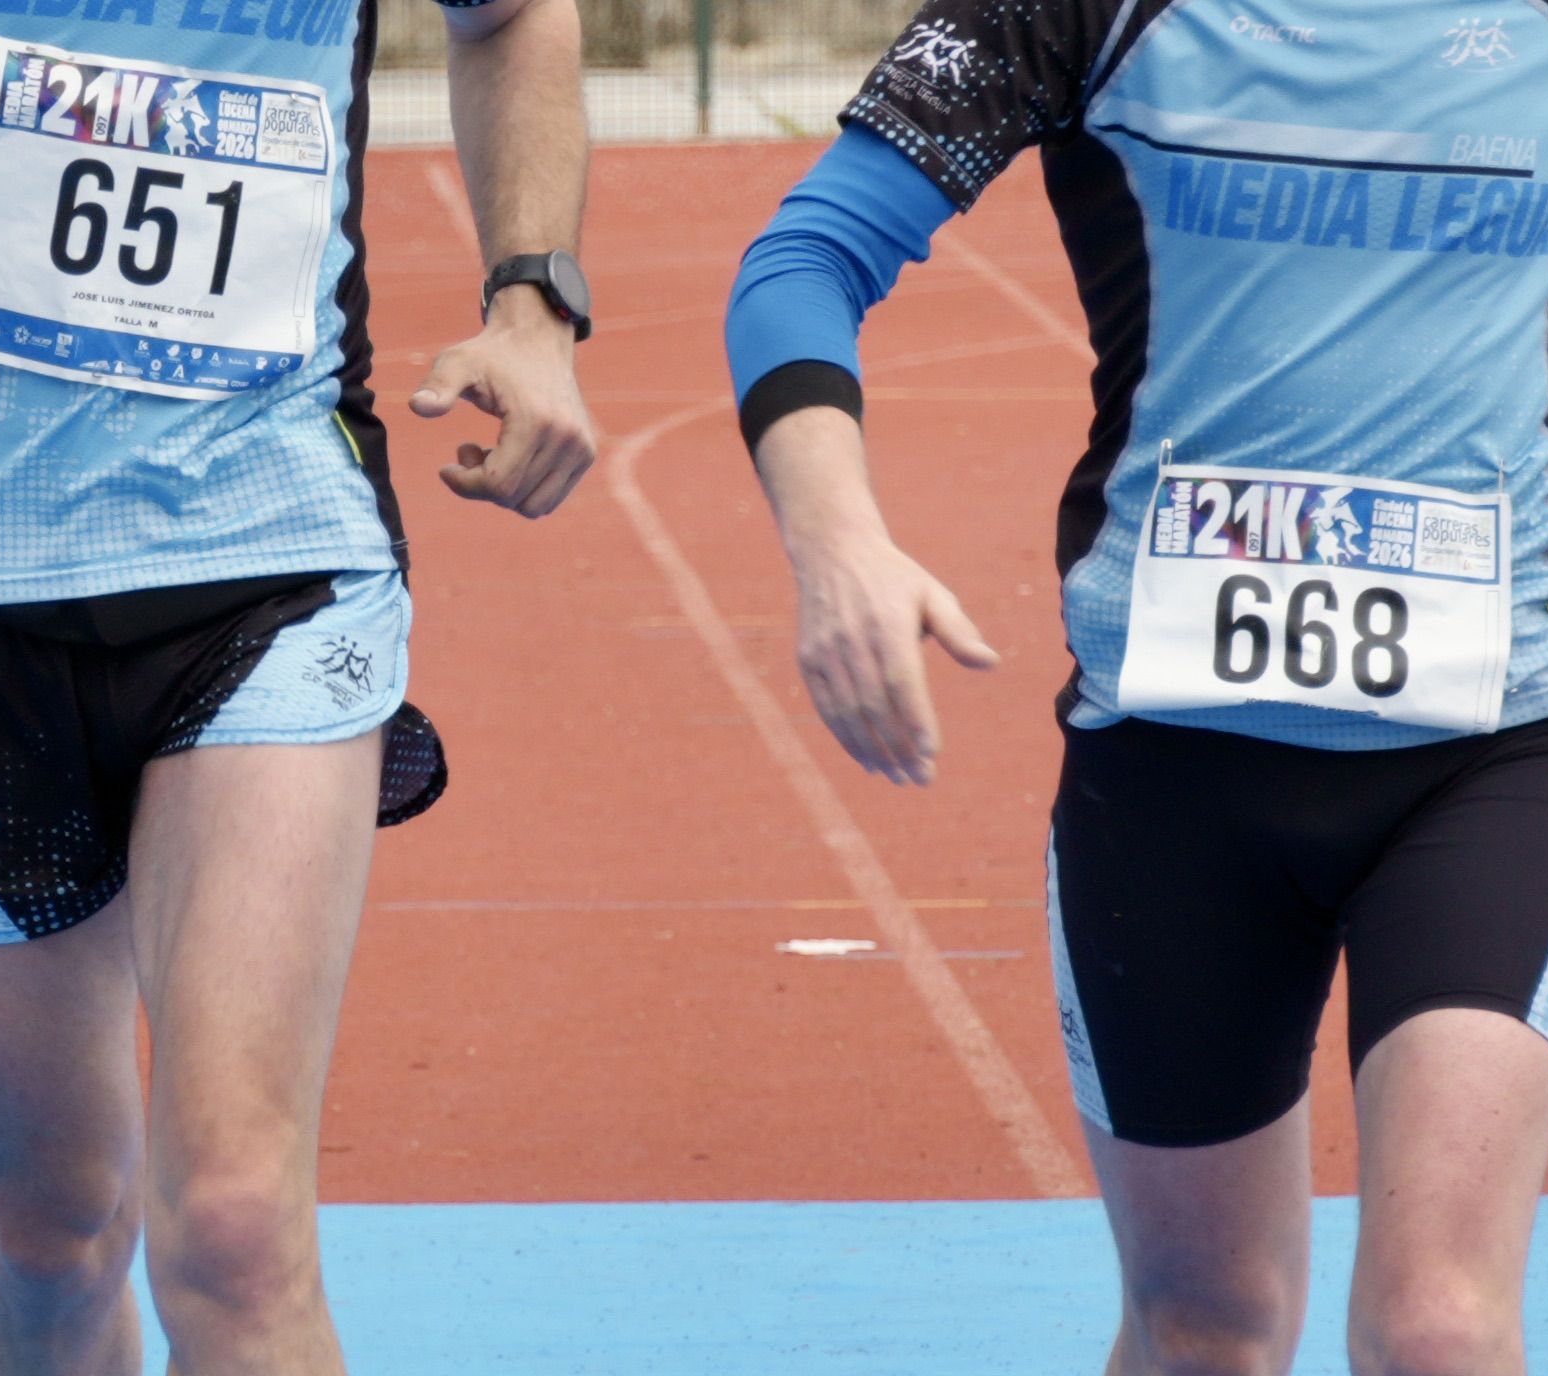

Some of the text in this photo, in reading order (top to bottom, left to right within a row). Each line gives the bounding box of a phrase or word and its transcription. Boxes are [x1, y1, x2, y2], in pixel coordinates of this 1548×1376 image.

[1252, 21, 1317, 45] TACTIC
[40, 64, 160, 148] 21K
[217, 102, 256, 121] LUCENA
[214, 132, 255, 160] 2026
[1450, 134, 1537, 167] BAENA
[1165, 156, 1371, 249] MEDIA
[48, 159, 244, 297] 651
[72, 291, 216, 320] JOSE LUIS JIMENEZ ORTEGA
[148, 319, 158, 330] M
[1193, 480, 1307, 561] 21K
[1423, 515, 1479, 535] carreras
[1421, 527, 1491, 548] populares
[1367, 540, 1413, 569] 2026
[1212, 573, 1410, 699] 668
